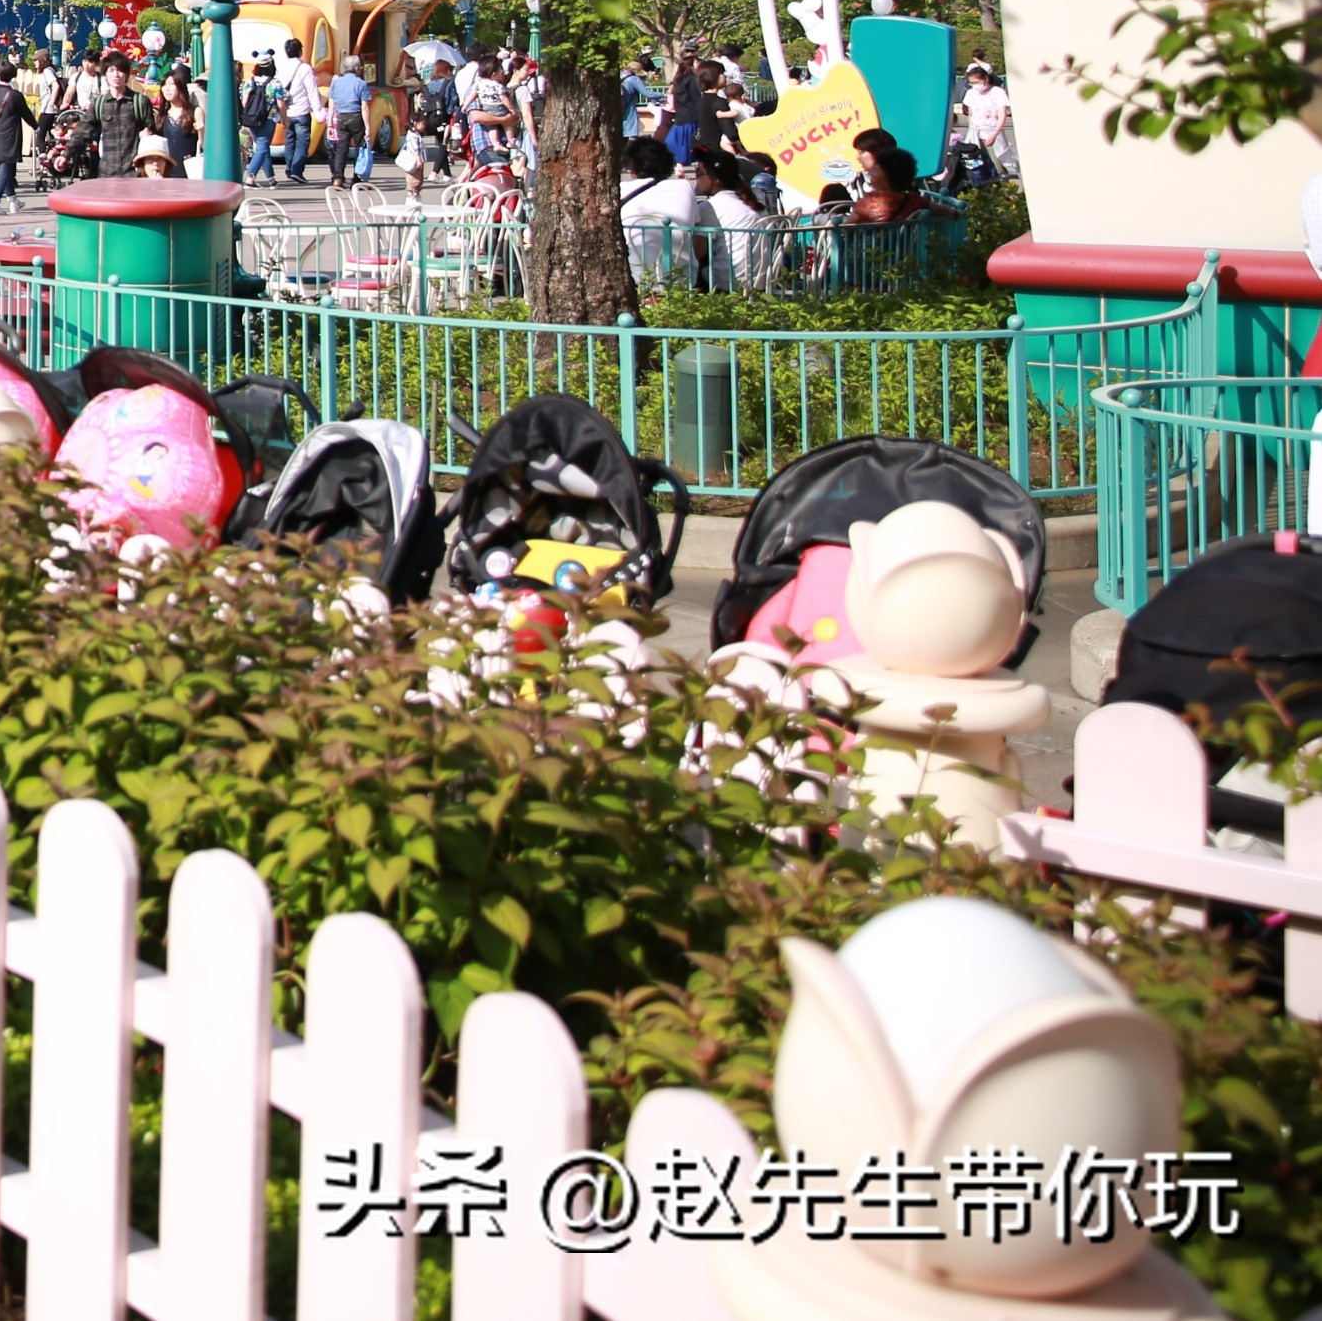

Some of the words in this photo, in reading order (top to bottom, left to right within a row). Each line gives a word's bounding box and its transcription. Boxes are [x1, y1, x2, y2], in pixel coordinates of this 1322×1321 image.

[768, 133, 784, 148] Our
[784, 115, 807, 134] Food
[807, 111, 817, 120] is
[819, 99, 853, 115] Simply
[778, 109, 861, 166] DUCKY!
